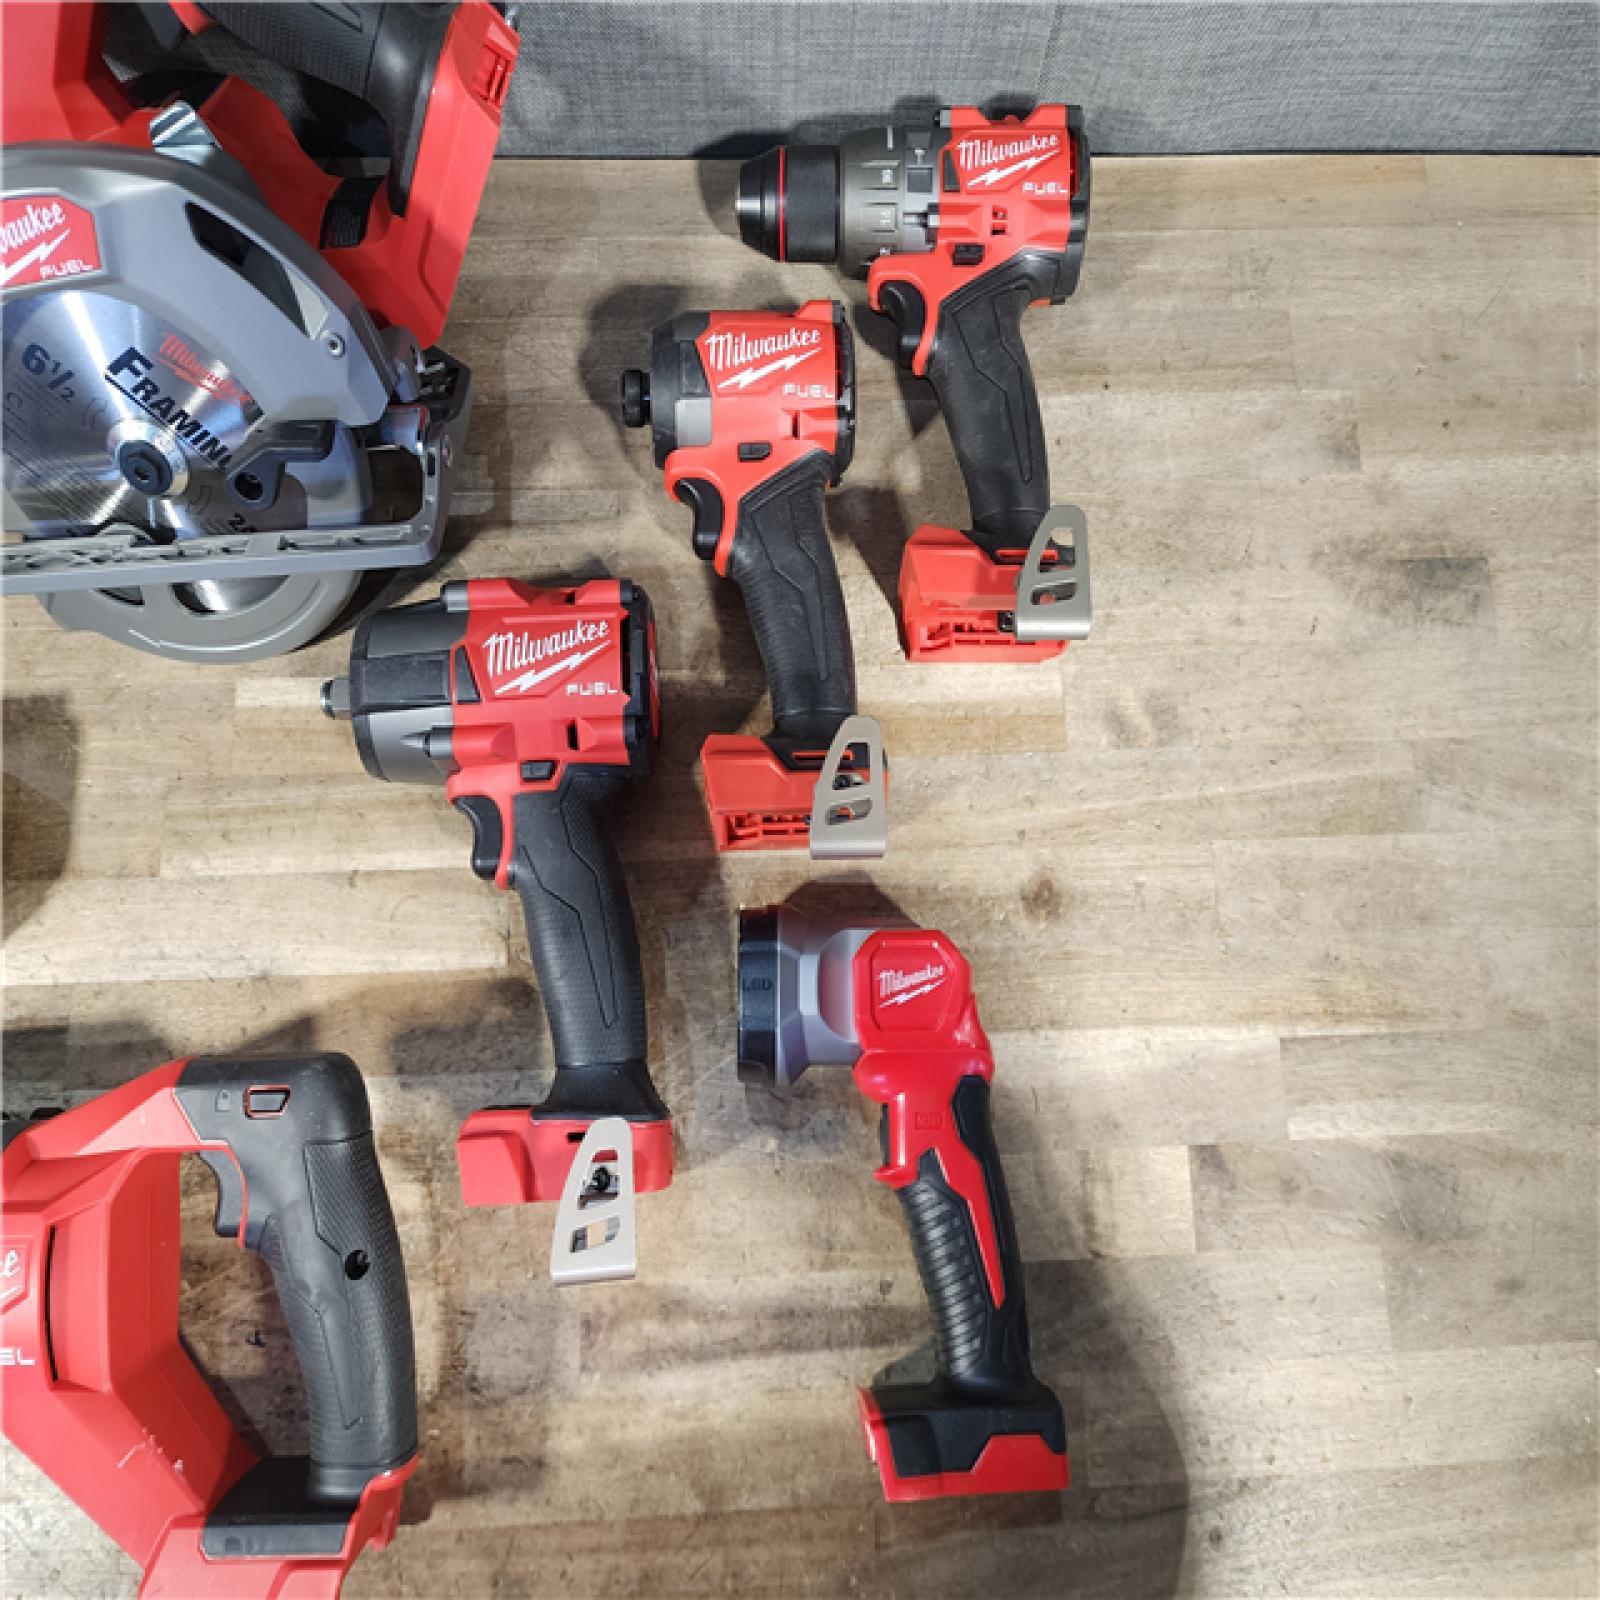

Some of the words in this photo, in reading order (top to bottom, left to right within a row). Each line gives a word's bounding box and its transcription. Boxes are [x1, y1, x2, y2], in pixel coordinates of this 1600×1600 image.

[957, 134, 1059, 170] Milwaukee
[705, 327, 821, 371] Milwaukee
[783, 382, 836, 399] FUEL
[482, 619, 611, 680] Milwaukee
[566, 682, 619, 697] FUEL
